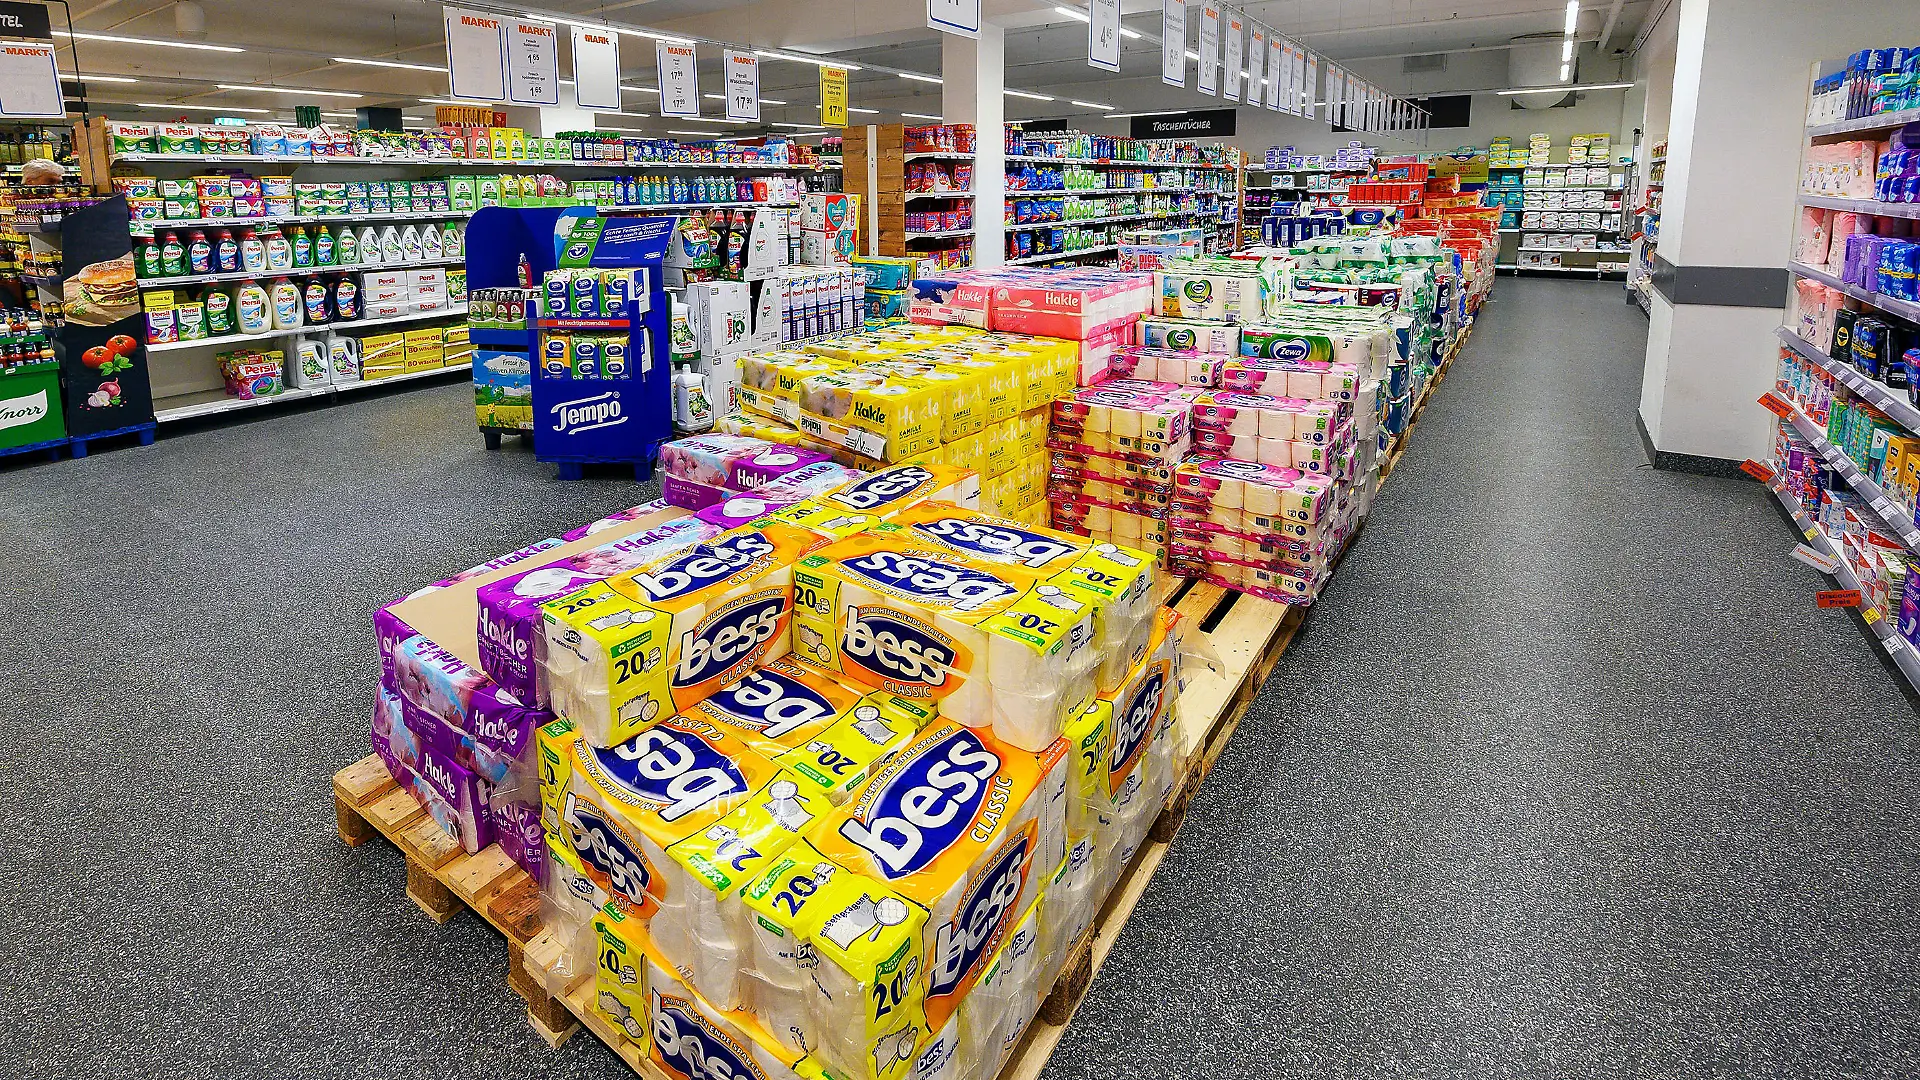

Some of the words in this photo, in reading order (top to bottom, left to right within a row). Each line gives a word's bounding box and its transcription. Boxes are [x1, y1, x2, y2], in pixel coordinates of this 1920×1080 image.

[461, 15, 499, 30] MARKT
[518, 25, 552, 37] MARKT
[6, 47, 49, 57] MARKT
[667, 47, 693, 57] MARKT
[733, 56, 756, 66] MARKT
[120, 127, 149, 136] Persil
[165, 127, 194, 136] Persil
[378, 277, 396, 285] Persil
[208, 301, 227, 309] Persil
[277, 295, 295, 303] Persil
[306, 293, 324, 301] Persil
[419, 302, 436, 310] Persil
[957, 288, 983, 304] Hakle
[1045, 292, 1079, 307] Hakle
[379, 307, 397, 315] Persil
[408, 346, 418, 354] 80
[1280, 347, 1302, 357] Zewa
[244, 363, 278, 376] Persil
[552, 398, 622, 432] Tempo
[854, 400, 886, 425] Hakle
[779, 464, 832, 487] Hakle
[828, 464, 935, 510] bess
[787, 506, 809, 522] 20
[613, 522, 690, 553] Hakle
[929, 517, 1071, 569] bess
[855, 550, 1006, 611] bess
[1086, 570, 1123, 588] 20
[559, 598, 595, 615] 20
[794, 585, 817, 609] 20
[1819, 591, 1858, 601] Discount-
[1829, 598, 1851, 606] Preis
[705, 597, 741, 623] RICHTIGEN
[869, 607, 903, 619] RICHTIGEN
[903, 615, 922, 628] ENDE
[477, 602, 528, 660] Hakle
[1019, 614, 1060, 635] 20
[678, 605, 778, 681] bess
[847, 605, 946, 686] bess
[614, 650, 645, 685] 20
[720, 644, 766, 685] CLASSIC
[883, 680, 932, 698] CLASSIC
[1113, 681, 1160, 767] bess
[817, 750, 858, 776] 20
[895, 746, 917, 768] ENDE
[425, 752, 456, 800] Hakle
[583, 759, 602, 782] ENDE
[600, 779, 641, 807] RICHTIGEN
[858, 765, 897, 806] RICHTIGEN
[640, 802, 661, 812] AM
[839, 740, 1001, 873] bess
[853, 803, 864, 819] AM
[969, 776, 1013, 843] CLASSIC
[571, 877, 595, 895] bess
[771, 875, 817, 917] 20
[825, 892, 871, 929] Softprägung
[929, 852, 1024, 988] bess
[872, 968, 904, 1024] 20
[675, 998, 709, 1030] RICHTIGEN
[709, 1023, 732, 1045] ENDE
[917, 1037, 945, 1075] bess
